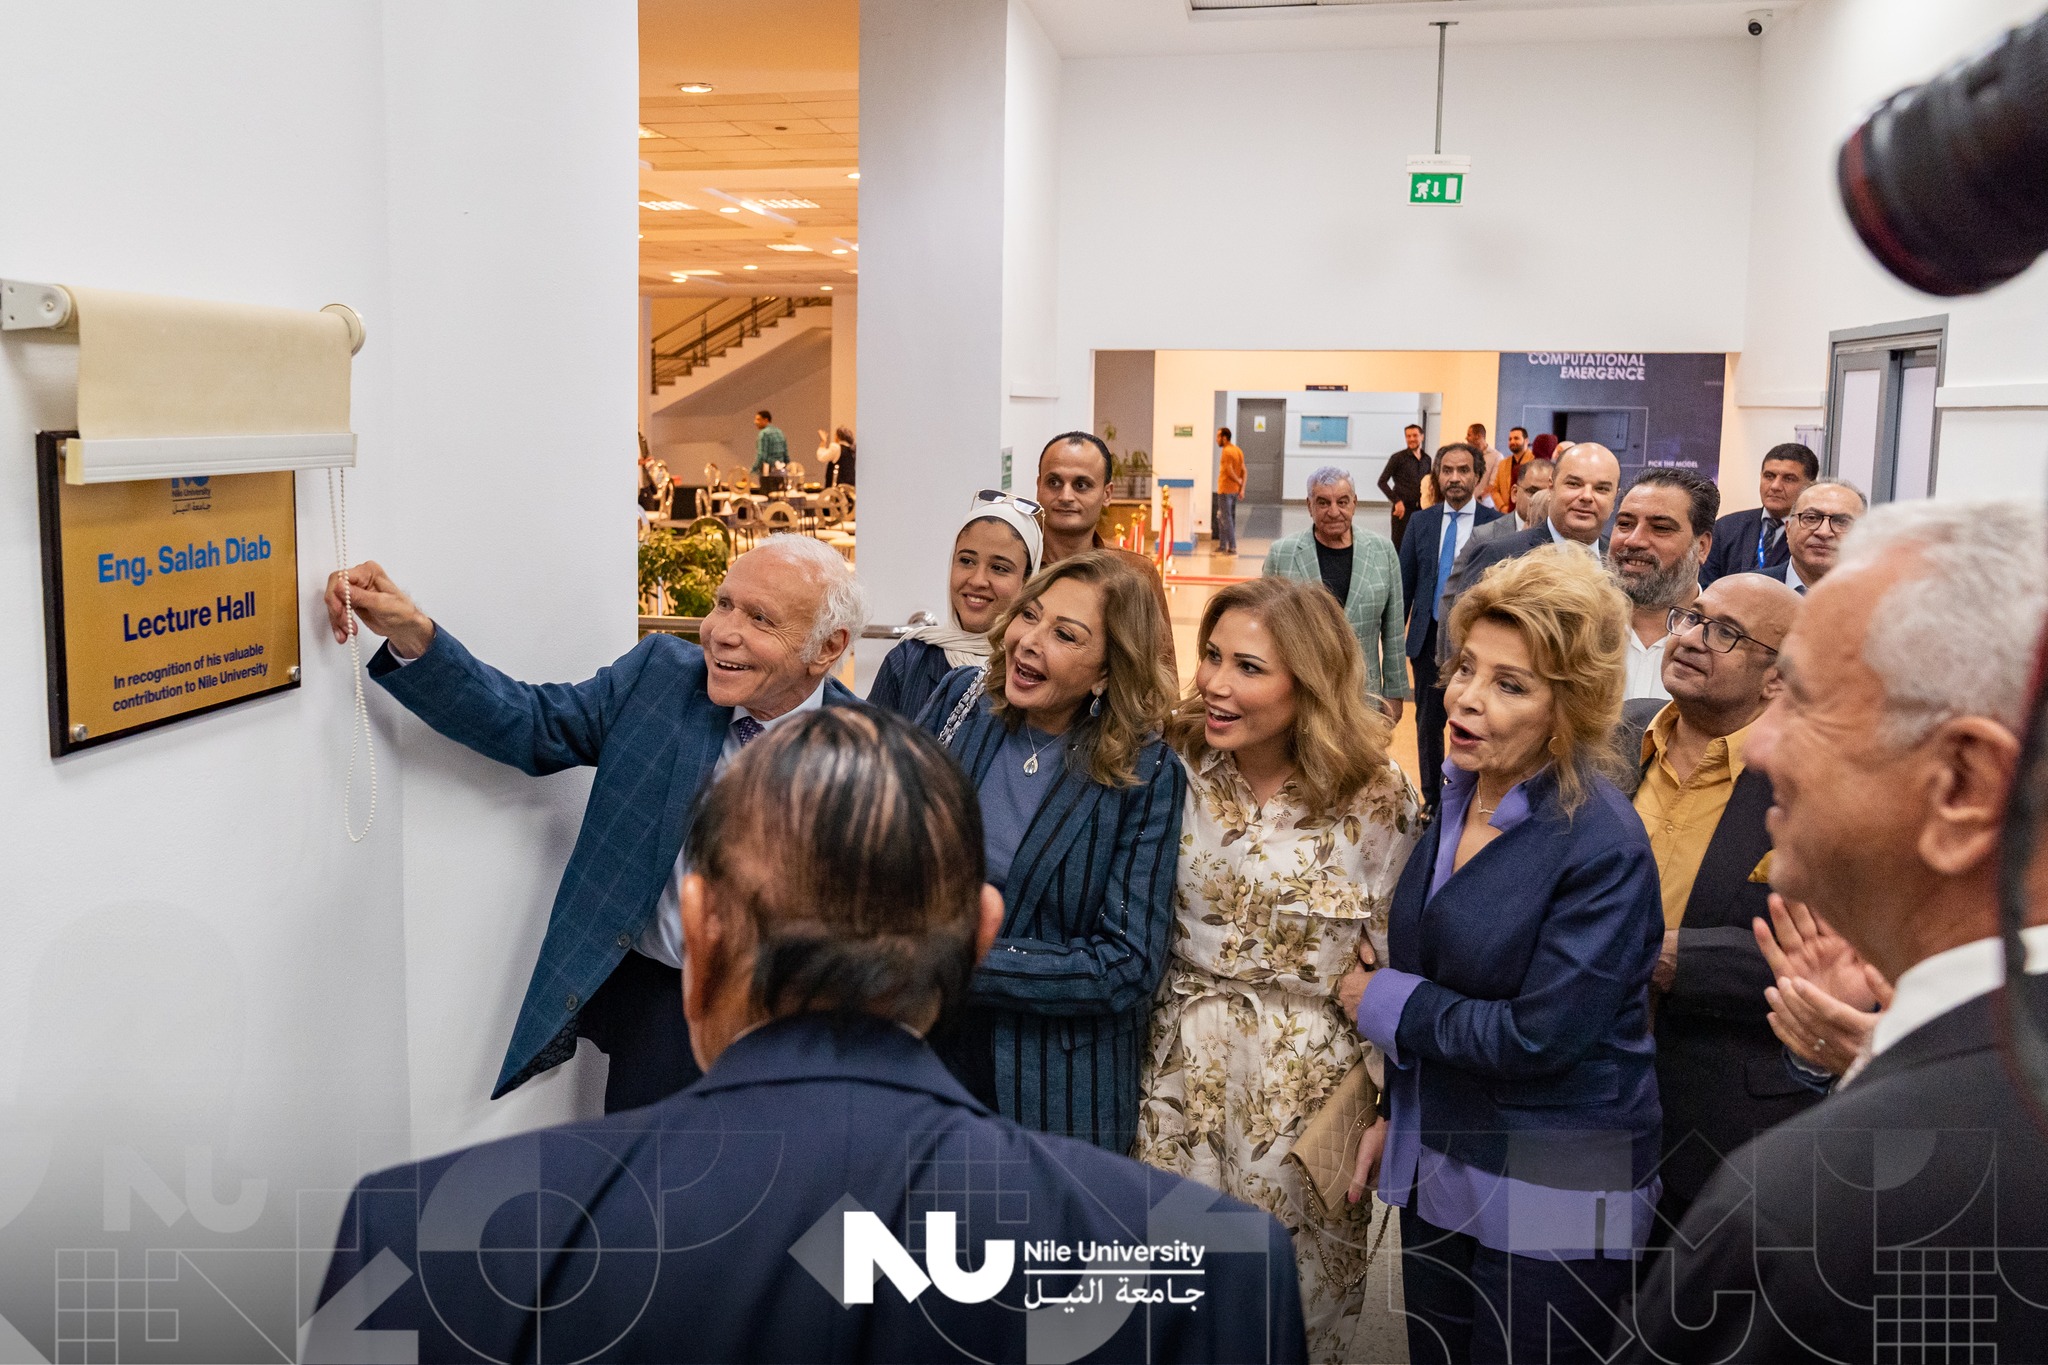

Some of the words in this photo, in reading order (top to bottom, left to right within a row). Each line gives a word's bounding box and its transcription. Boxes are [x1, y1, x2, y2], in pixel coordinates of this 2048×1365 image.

[1528, 353, 1646, 366] COMPUTATIONAL
[1559, 366, 1646, 380] EMERGENCE
[97, 552, 153, 587] Eng.
[158, 540, 221, 574] Salah
[225, 534, 271, 565] Diab
[123, 606, 212, 642] Lecture
[216, 591, 256, 623] Hall
[112, 684, 183, 712] contribution
[185, 680, 196, 694] to
[197, 674, 218, 690] Nile
[219, 662, 269, 685] University
[113, 675, 125, 690] In
[127, 661, 192, 687] recognition
[193, 655, 205, 671] of
[206, 653, 222, 668] his
[223, 643, 265, 663] valuable
